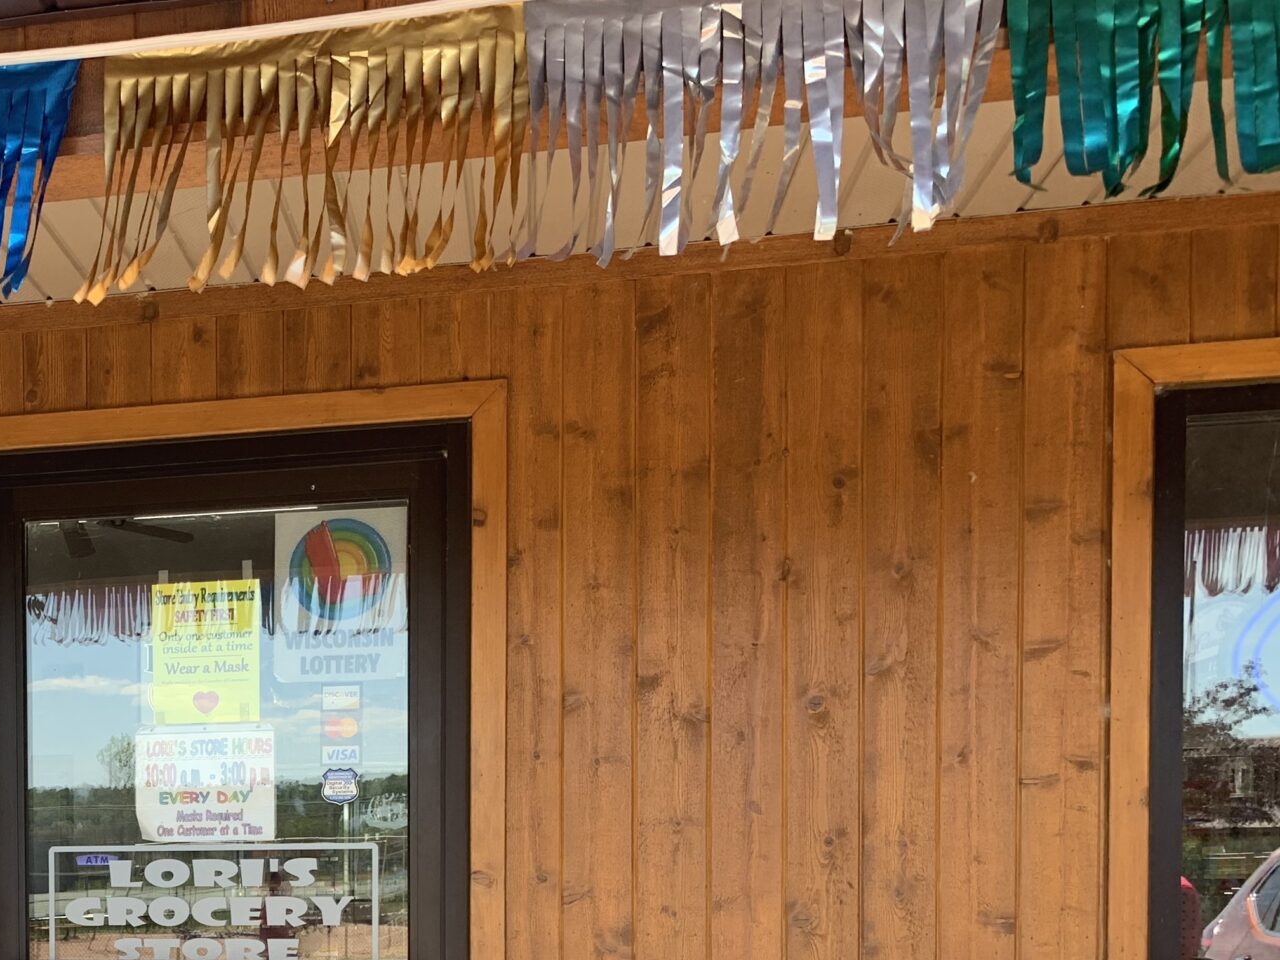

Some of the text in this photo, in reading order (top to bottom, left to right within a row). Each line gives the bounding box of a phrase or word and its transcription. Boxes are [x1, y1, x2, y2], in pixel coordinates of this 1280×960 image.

[155, 589, 176, 606] Store
[174, 607, 235, 623] SAFETY FIRST
[158, 629, 253, 646] Only one customer
[284, 627, 395, 650] WISCONSIN
[162, 642, 198, 655] inside
[199, 642, 213, 653] at
[226, 641, 253, 652] time
[165, 657, 250, 675] Wear a Mask
[300, 653, 382, 675] LOTTERY
[146, 737, 273, 758] LORI'S STORE HOURS
[326, 749, 358, 761] VISA
[145, 762, 177, 788] 10:00
[158, 789, 251, 805] EVERY DAY
[176, 808, 244, 824] Masks Required
[156, 823, 263, 837] One Customer at a Time
[85, 855, 110, 865] ATM
[108, 857, 319, 888] LORI'S
[64, 895, 355, 928] GROCERY
